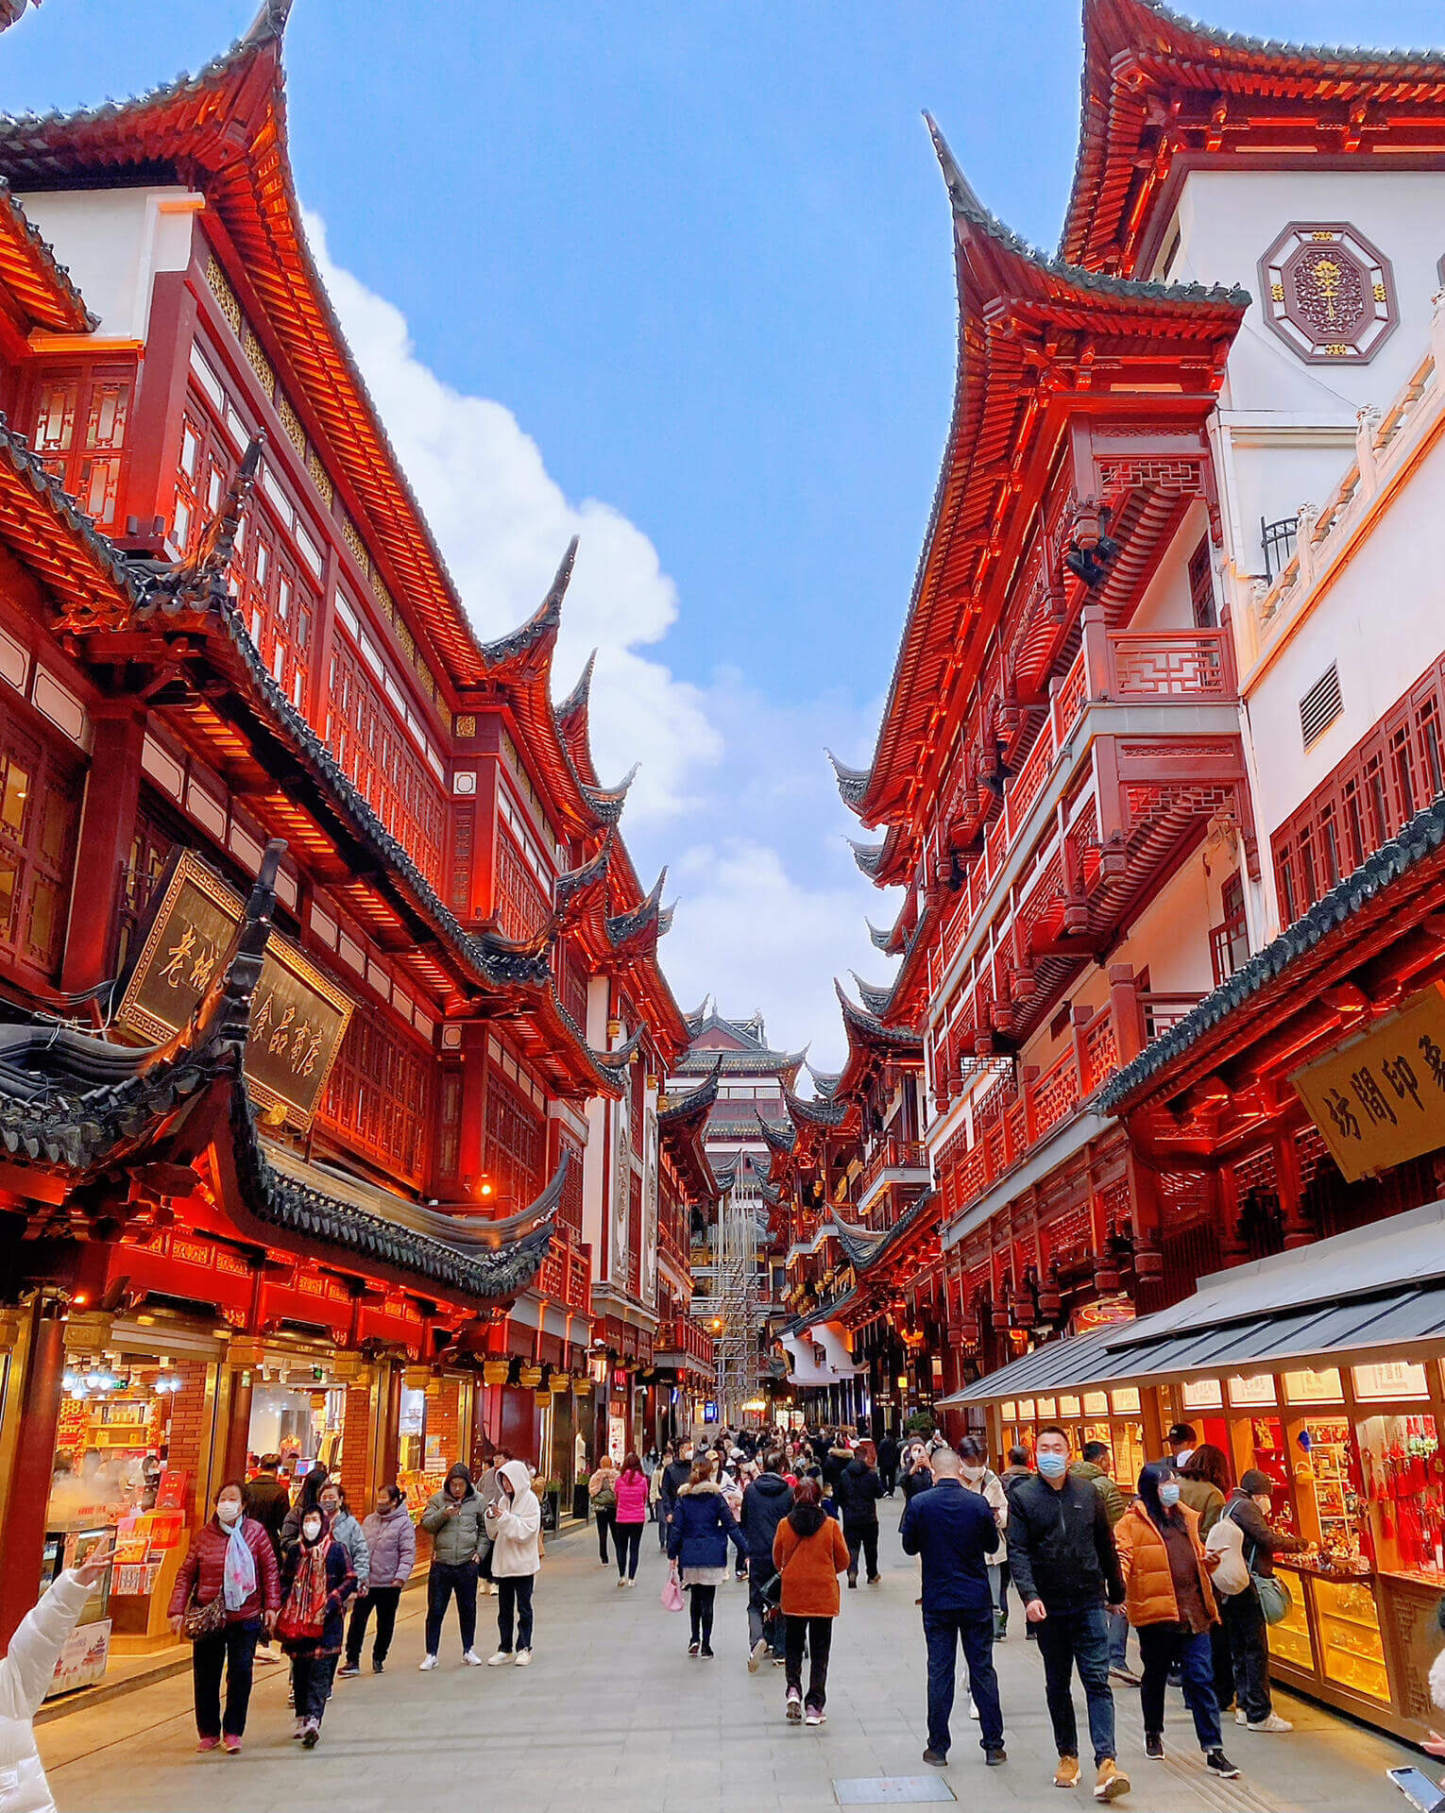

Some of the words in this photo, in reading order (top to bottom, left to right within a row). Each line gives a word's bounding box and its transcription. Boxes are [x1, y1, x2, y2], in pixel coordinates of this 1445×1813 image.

[158, 924, 324, 1078] 老城食品商店
